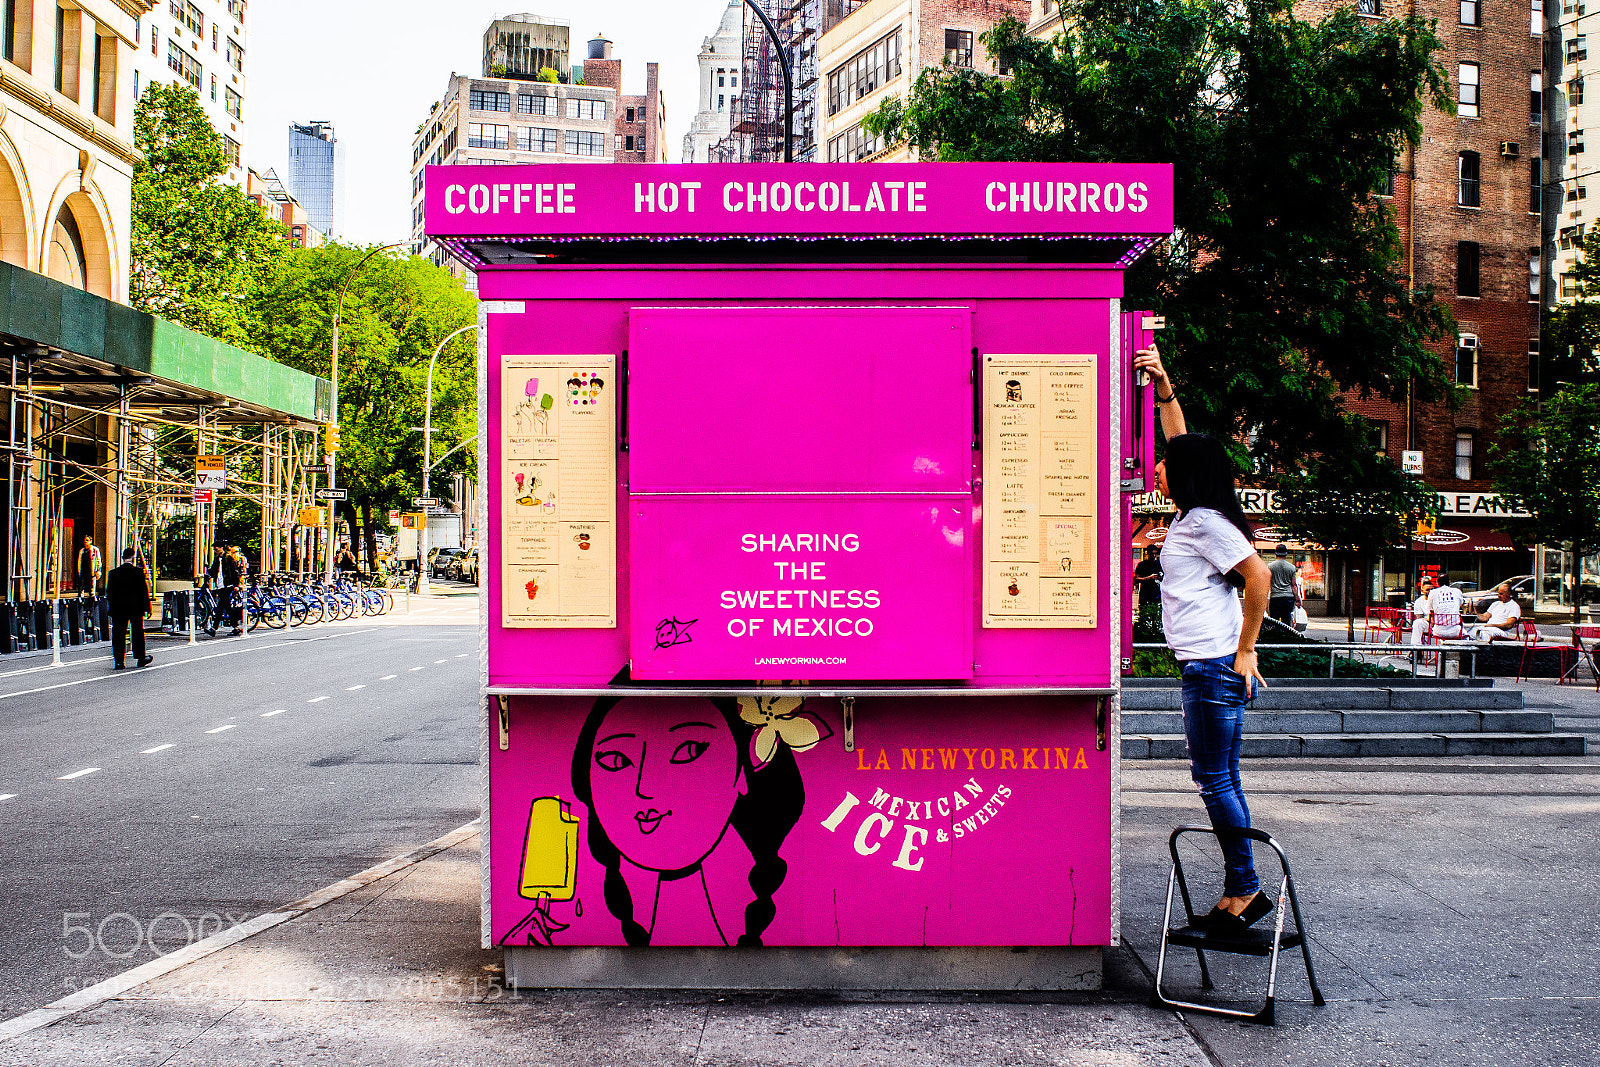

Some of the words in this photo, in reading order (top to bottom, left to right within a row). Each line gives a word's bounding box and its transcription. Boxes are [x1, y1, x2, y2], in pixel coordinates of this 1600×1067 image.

[445, 183, 576, 214] COFFEE
[634, 182, 701, 213] HOT
[723, 181, 927, 212] CHOCOLATE
[985, 182, 1149, 213] CHURROS
[1403, 463, 1423, 471] TURNS
[740, 532, 861, 553] SHARING
[773, 561, 827, 581] THE
[719, 589, 882, 609] SWEETNESS
[727, 618, 765, 638] OF
[772, 617, 874, 638] MEXICO
[754, 656, 847, 666] LANEWYORKINA.COM
[856, 748, 891, 771] LA
[900, 747, 1090, 771] NEWYORKINA
[867, 777, 984, 821] MEXICAN
[820, 790, 929, 872] ICE
[936, 828, 949, 843] &
[952, 783, 1013, 839] SWEETS
